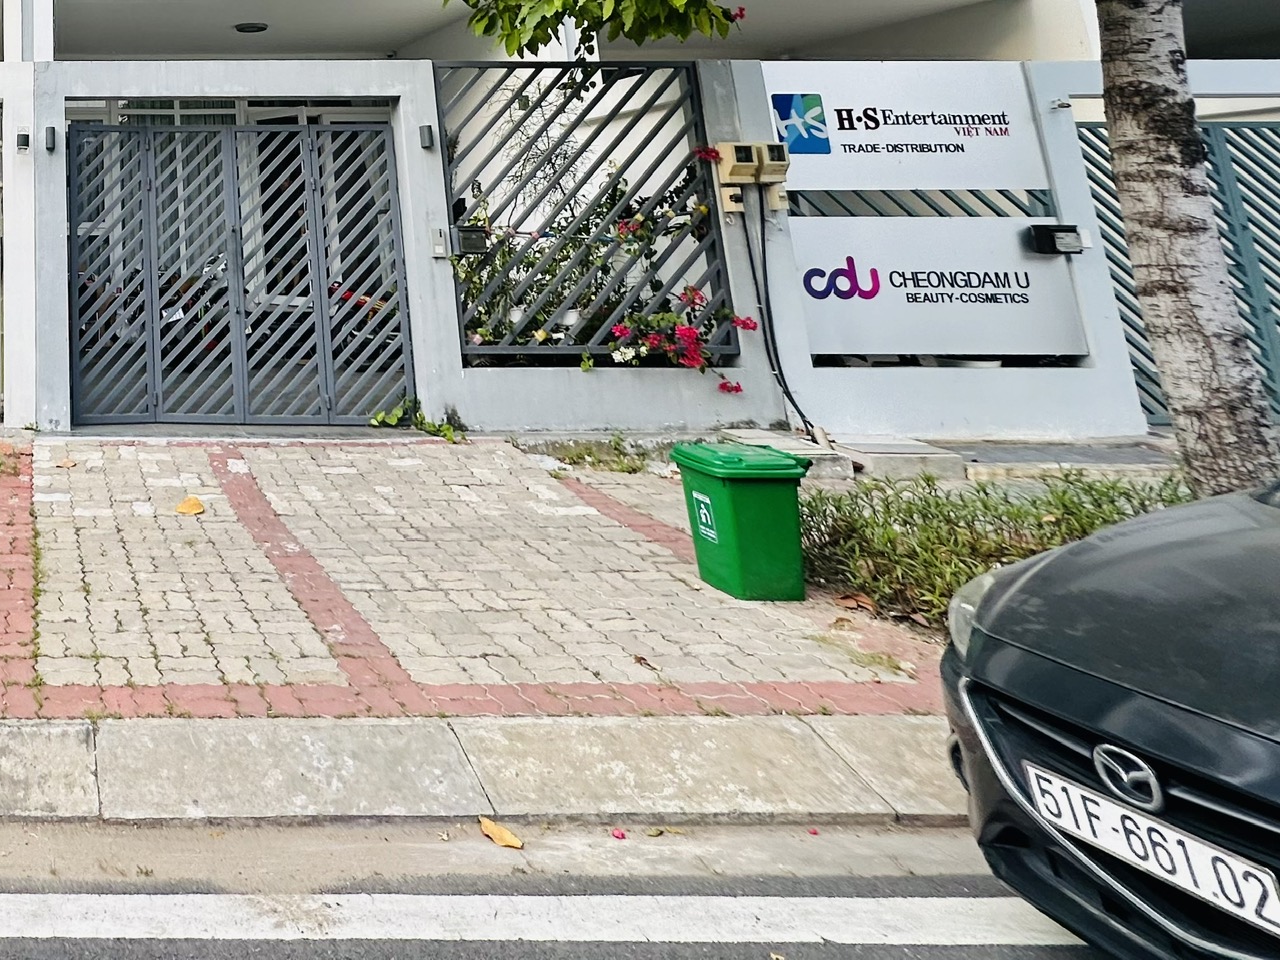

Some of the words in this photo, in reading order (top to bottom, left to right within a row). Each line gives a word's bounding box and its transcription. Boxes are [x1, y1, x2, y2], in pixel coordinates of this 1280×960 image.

[985, 126, 1010, 137] NAM
[841, 143, 965, 154] TRADE-DISTRIBUTION
[889, 270, 1012, 289] CHEONGDAM
[1014, 271, 1030, 289] U
[906, 292, 1030, 304] BEAUTY-COSMETICS
